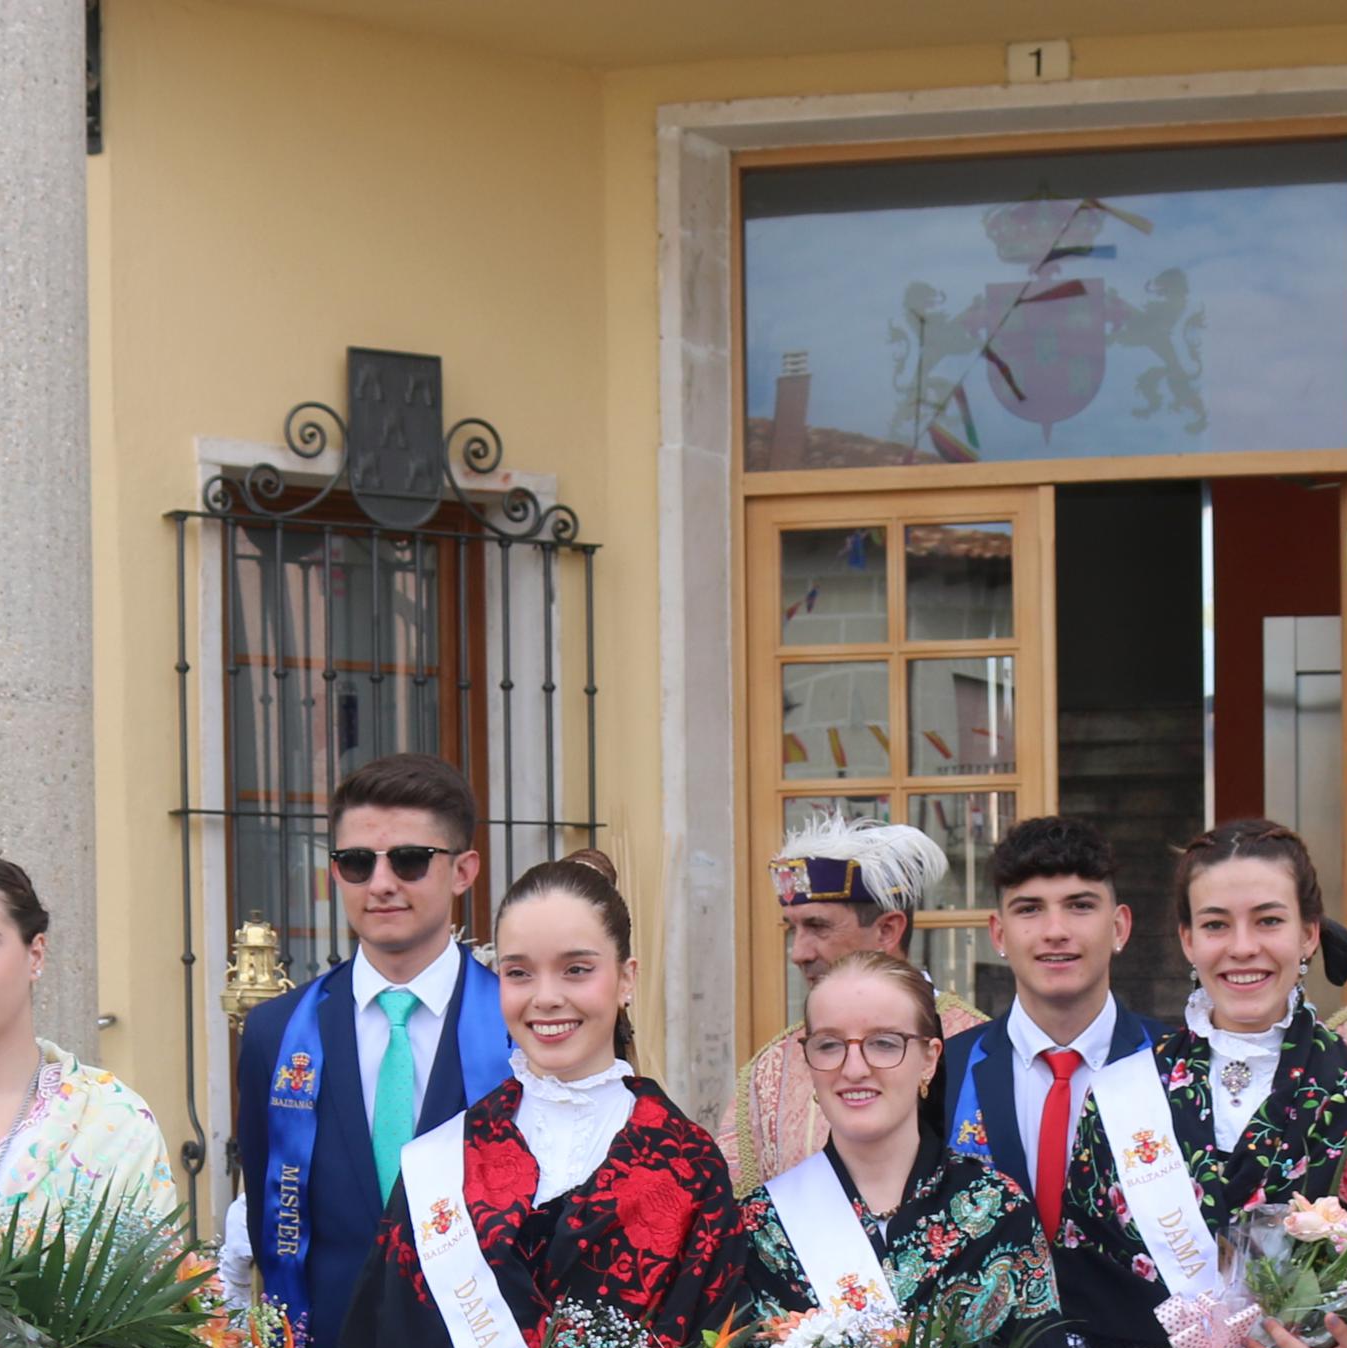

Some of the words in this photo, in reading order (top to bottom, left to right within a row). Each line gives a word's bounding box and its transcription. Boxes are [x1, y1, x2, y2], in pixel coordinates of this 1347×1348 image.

[1028, 47, 1042, 77] 1
[276, 1164, 301, 1258] MISTER
[422, 1227, 470, 1261] BALTANÁS
[1157, 1206, 1207, 1280] DAMA
